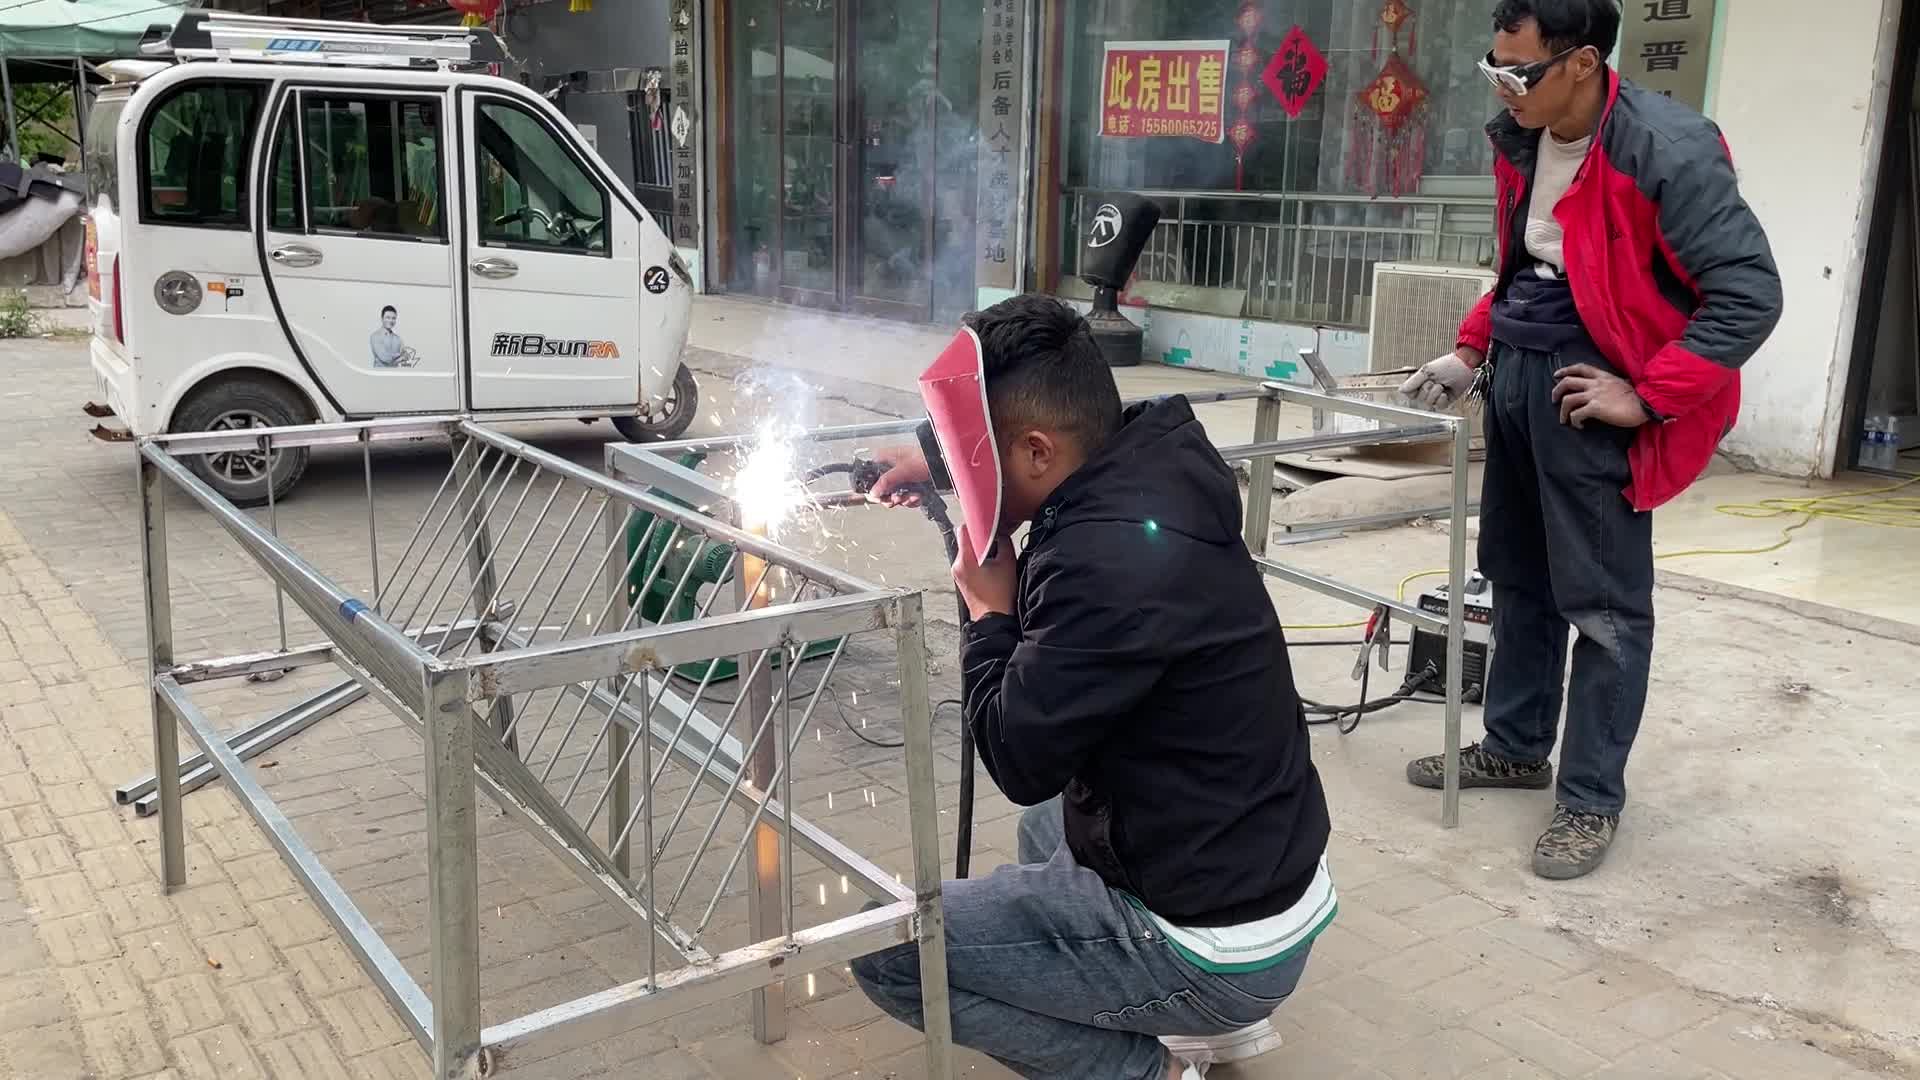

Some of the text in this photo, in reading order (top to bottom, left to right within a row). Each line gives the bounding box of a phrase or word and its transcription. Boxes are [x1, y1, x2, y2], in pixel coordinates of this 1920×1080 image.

[1640, 0, 1692, 98] 道晋
[1107, 55, 1222, 114] 此房出售
[1370, 77, 1400, 113] 福
[1141, 118, 1218, 138] 15560065225
